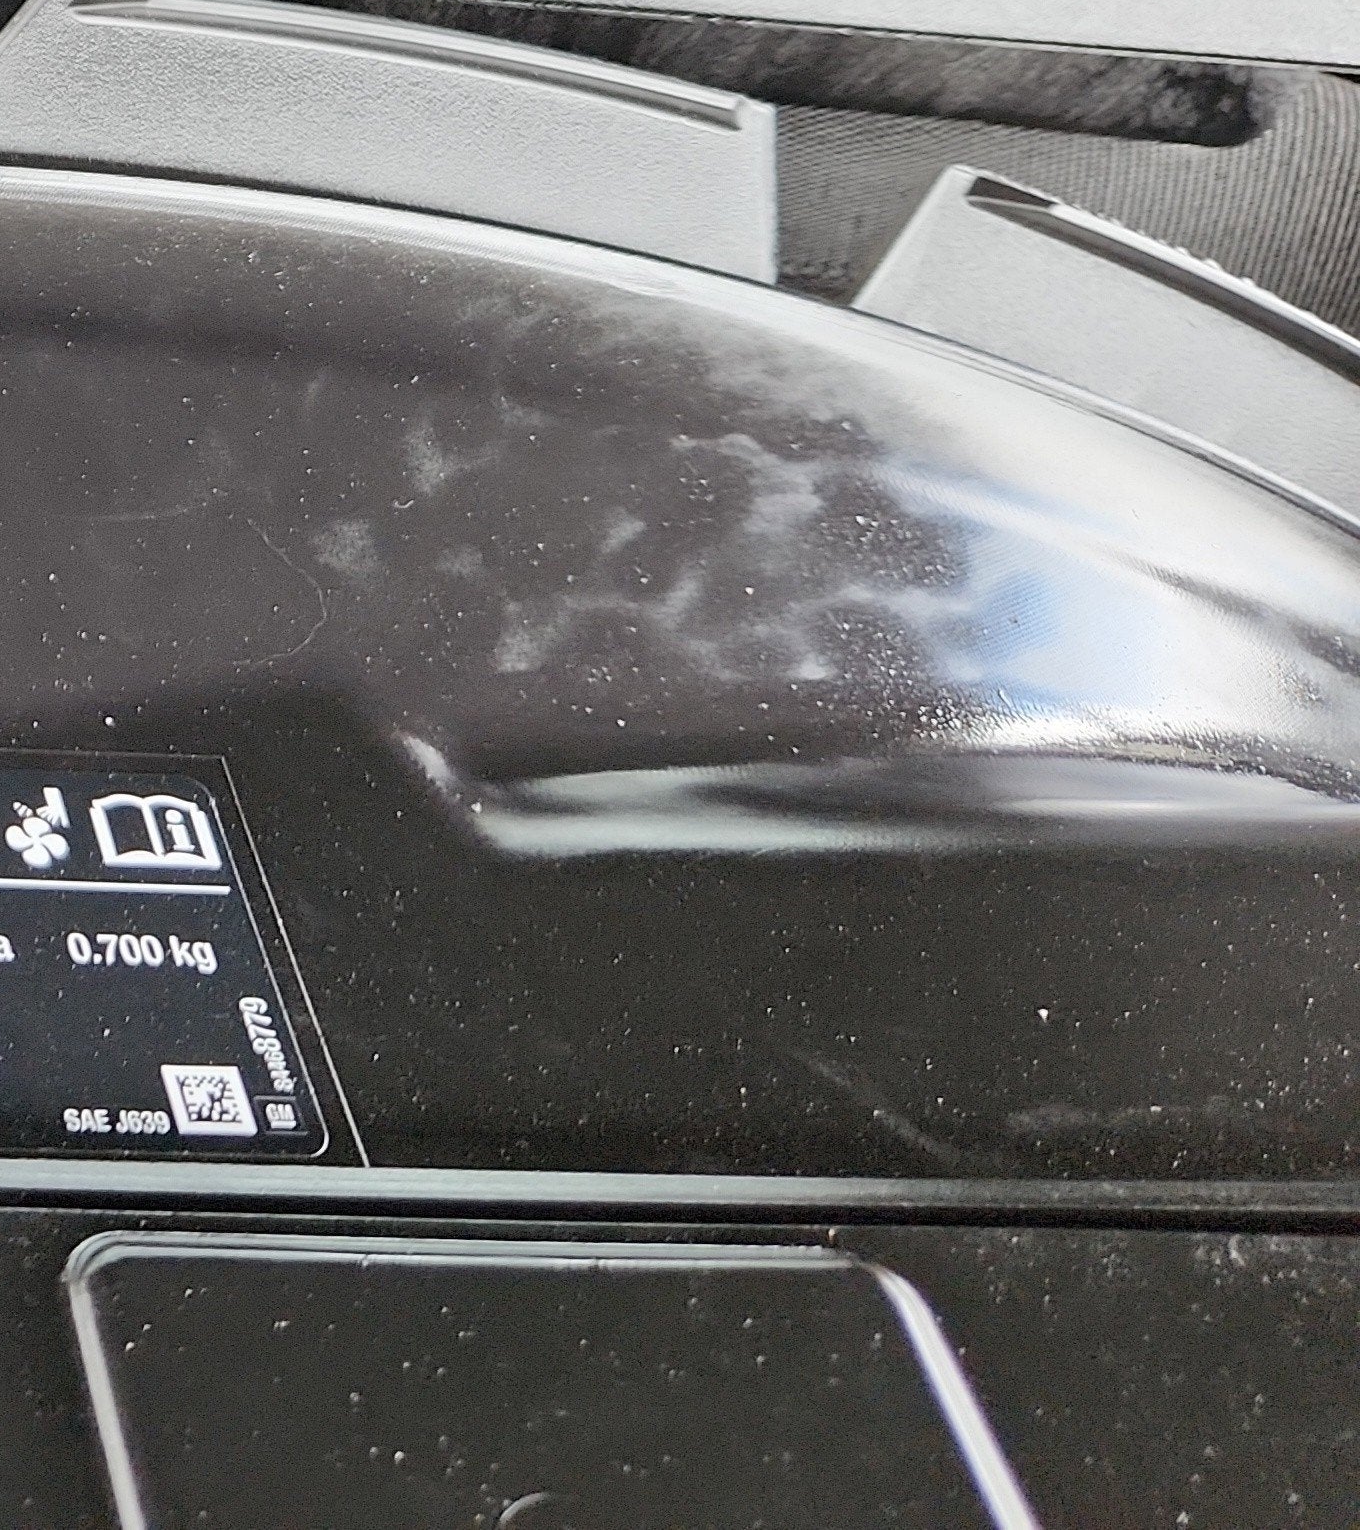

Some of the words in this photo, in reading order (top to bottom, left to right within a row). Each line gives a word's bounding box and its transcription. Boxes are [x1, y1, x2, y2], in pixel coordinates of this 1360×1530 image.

[66, 932, 165, 967] 0.700
[168, 934, 218, 975] kg
[62, 1107, 112, 1134] SAE
[115, 1108, 171, 1135] J639
[264, 1102, 298, 1130] GM
